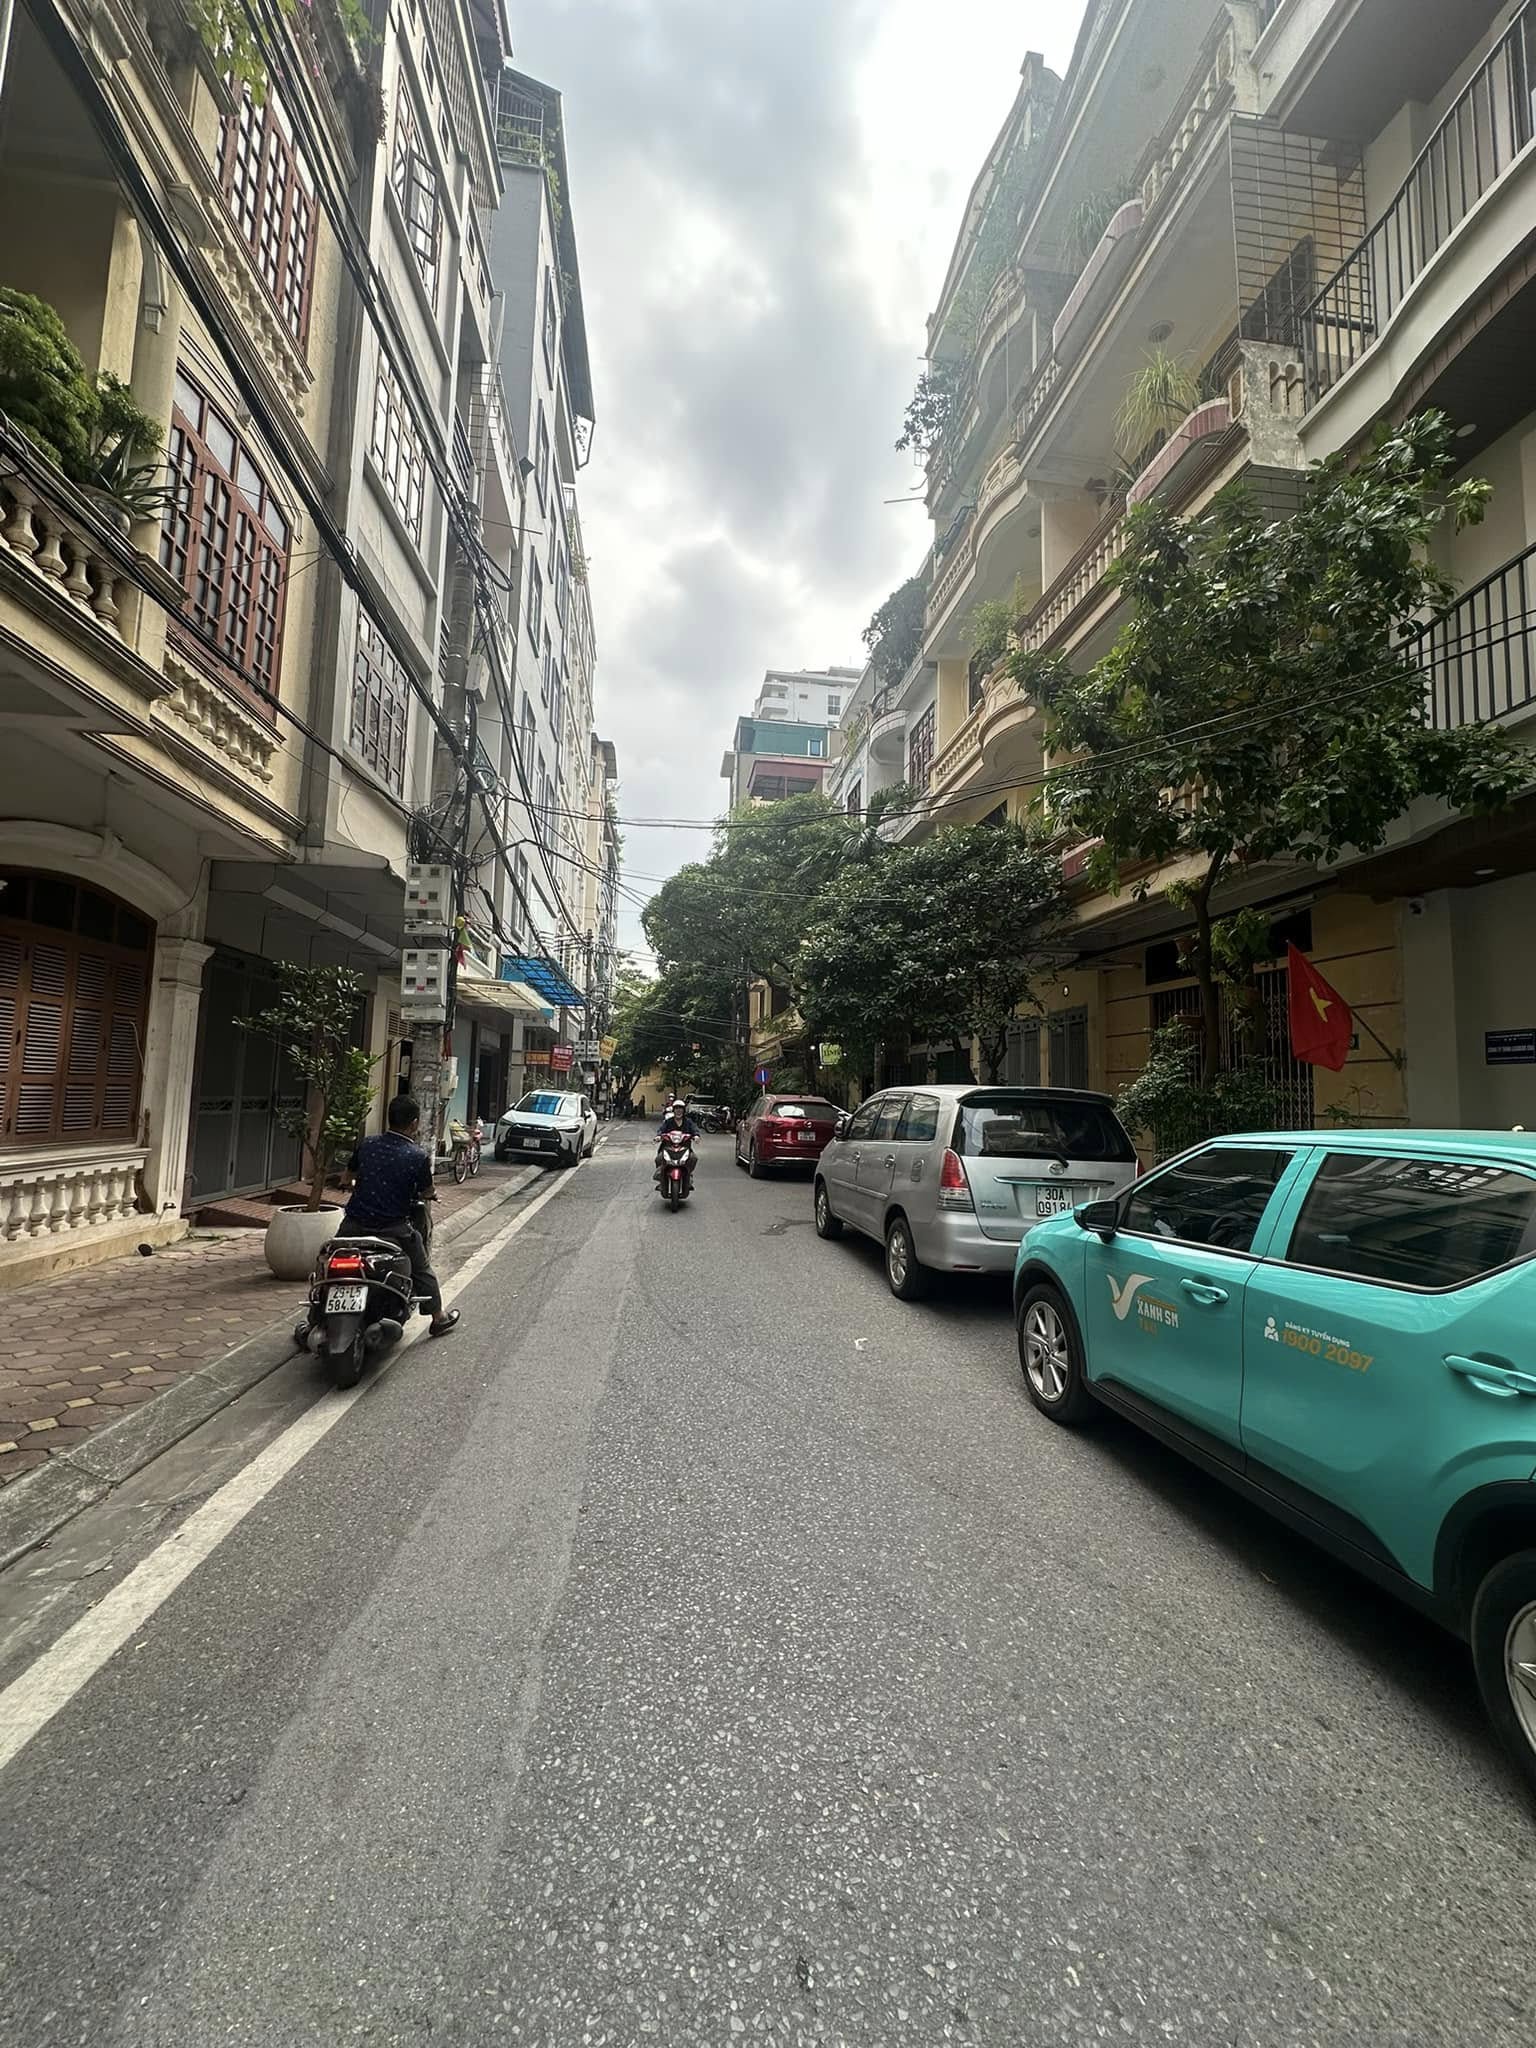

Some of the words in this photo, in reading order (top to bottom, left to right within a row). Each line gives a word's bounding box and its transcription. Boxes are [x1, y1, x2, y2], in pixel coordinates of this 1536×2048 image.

[1045, 1188, 1065, 1201] 30A
[1137, 1300, 1163, 1322] XANH
[1164, 1310, 1179, 1328] SM
[1283, 1329, 1322, 1354] 1900
[1324, 1343, 1375, 1373] 2097
